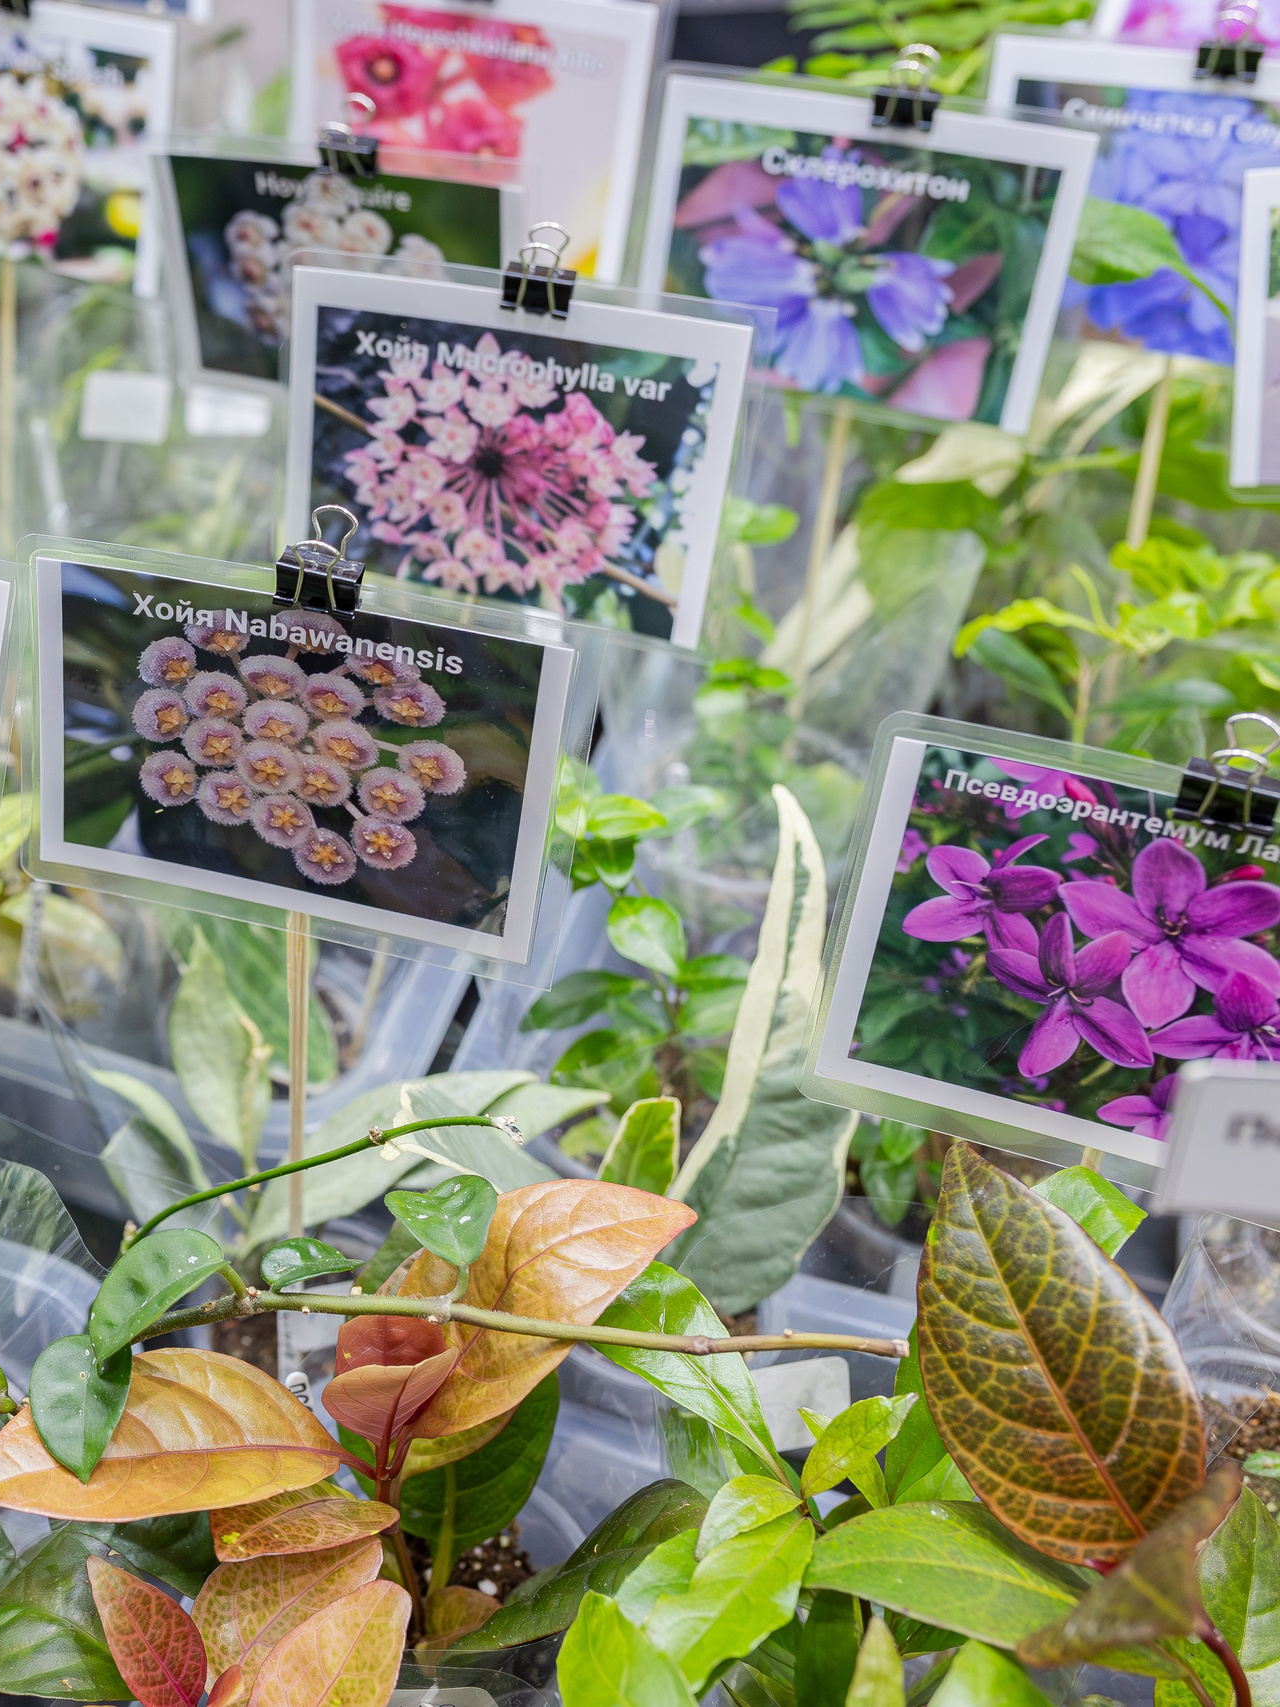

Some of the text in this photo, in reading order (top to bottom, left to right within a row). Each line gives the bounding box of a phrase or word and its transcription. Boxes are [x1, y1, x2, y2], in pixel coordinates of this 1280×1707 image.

[761, 145, 970, 203] Склерохитон
[356, 330, 672, 401] Хойя Macrophylla var
[132, 592, 464, 675] Хойя Nabawanensis
[943, 769, 1232, 851] Псевдоэрантемум
